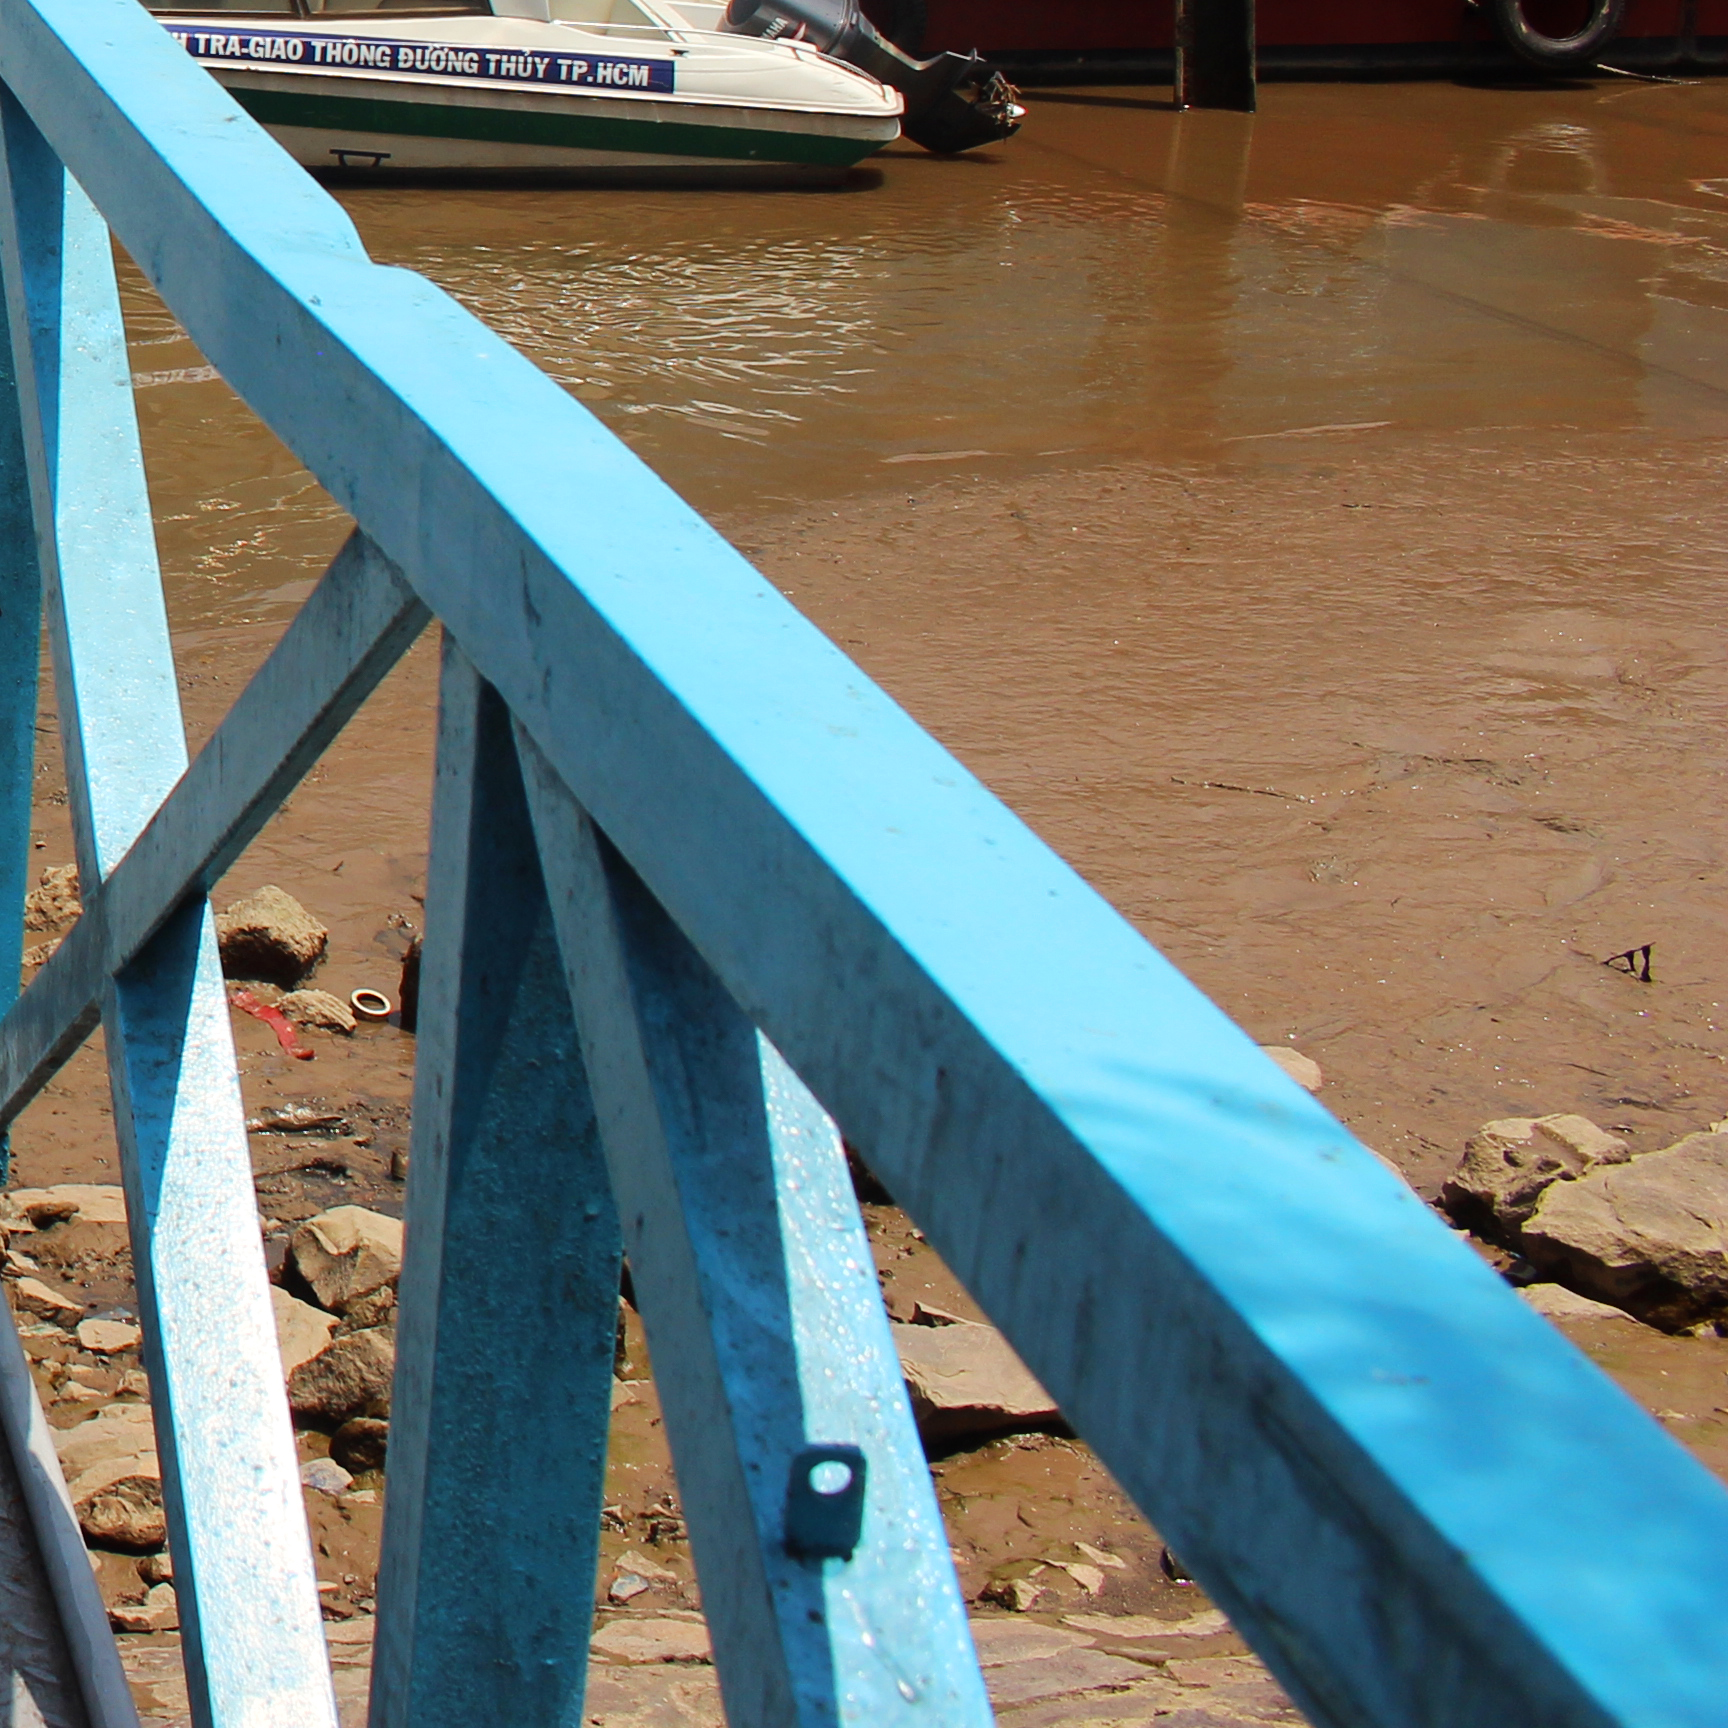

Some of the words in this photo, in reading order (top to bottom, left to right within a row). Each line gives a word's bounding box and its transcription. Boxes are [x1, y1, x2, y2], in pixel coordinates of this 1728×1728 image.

[762, 17, 789, 40] MAHA
[196, 33, 303, 62] TRA-GIAO
[312, 38, 391, 70] THÔNG
[398, 43, 478, 75] ĐƯỜNG
[485, 48, 548, 80] THỦY
[557, 58, 650, 87] TP.HCM
